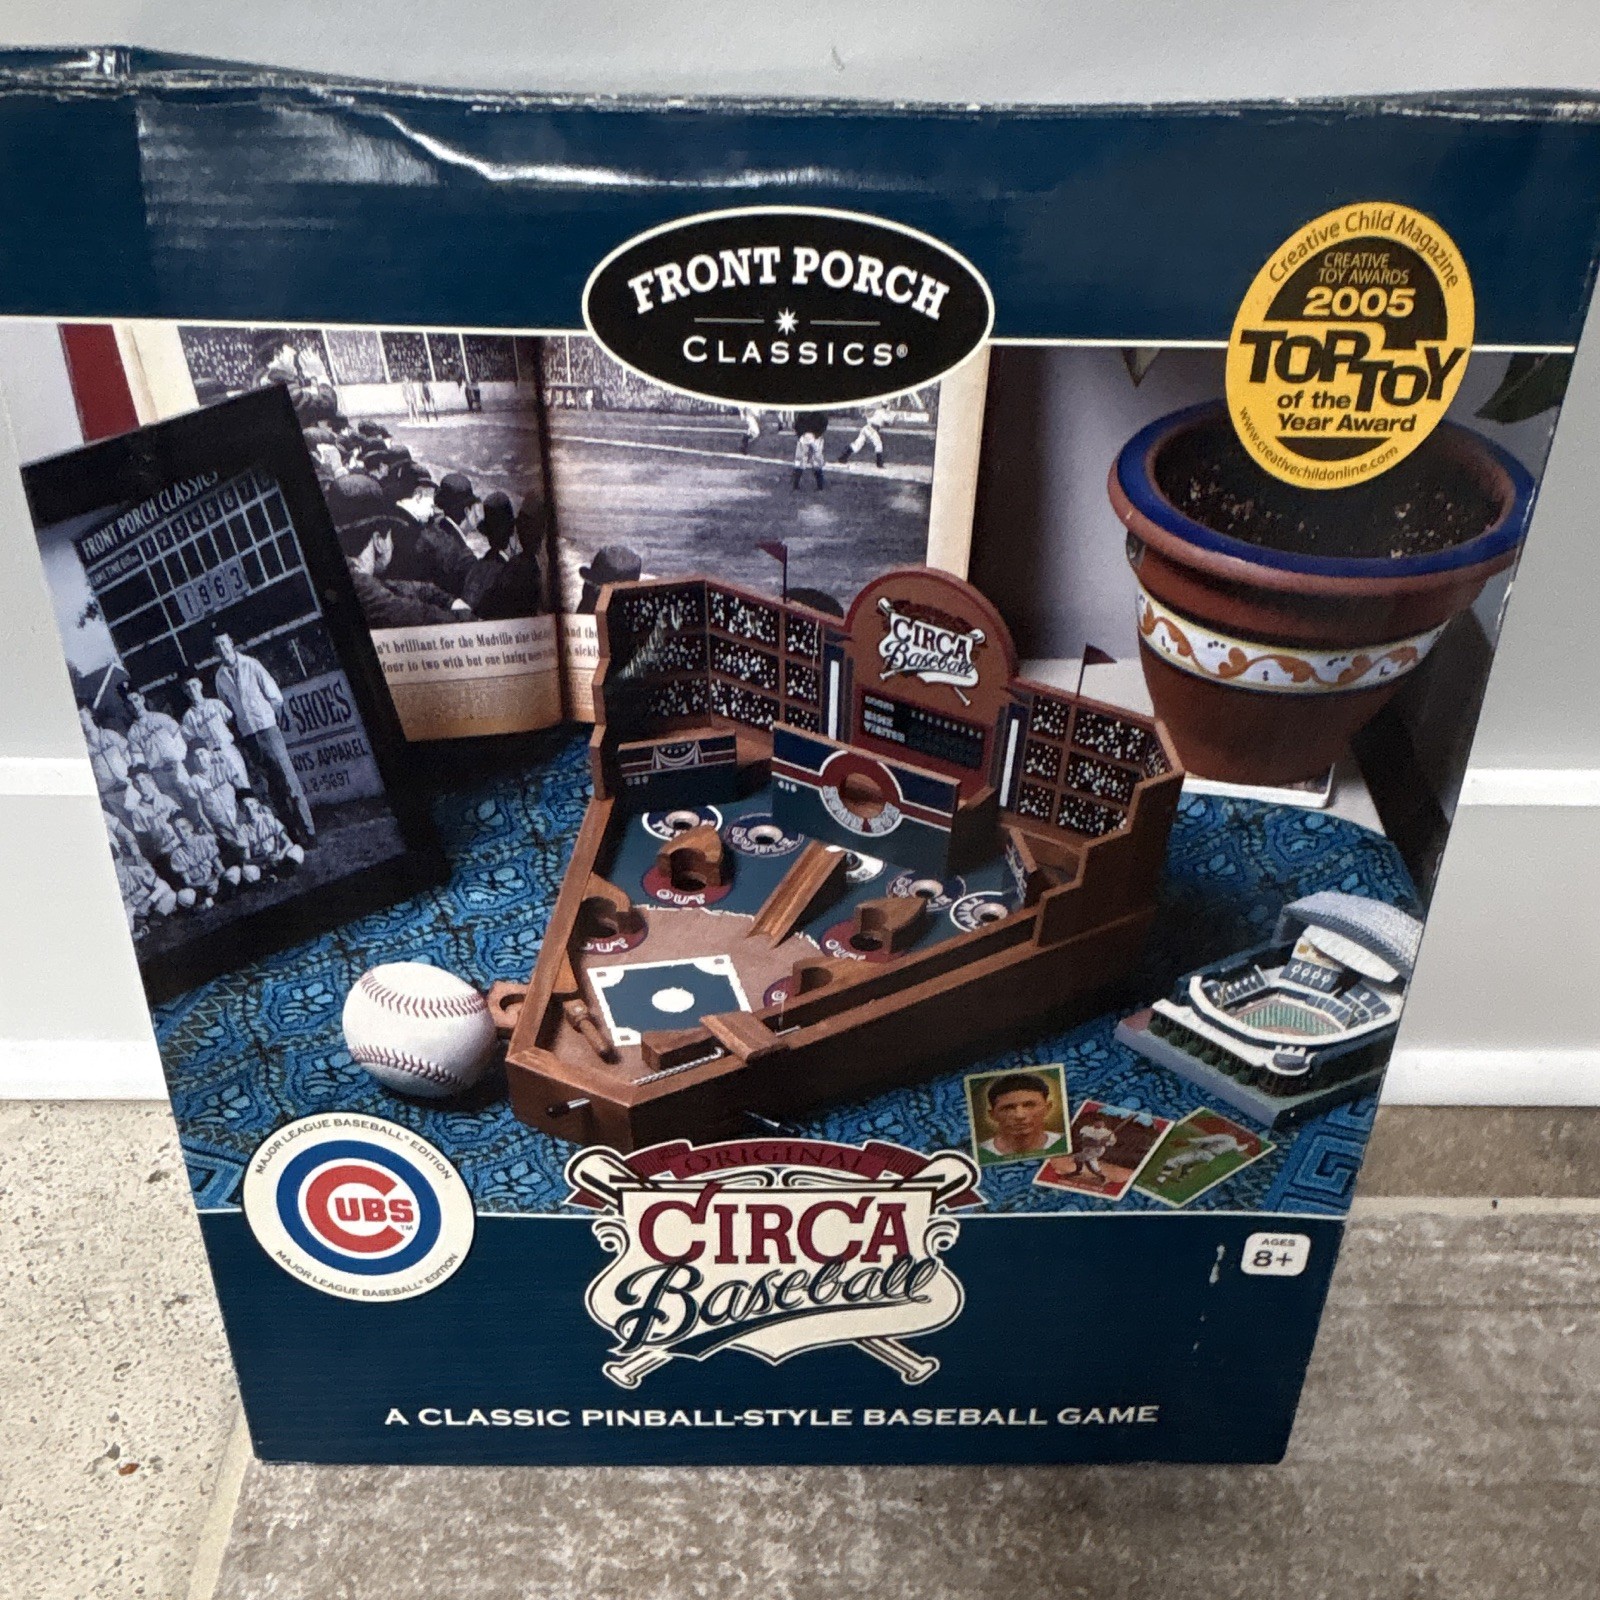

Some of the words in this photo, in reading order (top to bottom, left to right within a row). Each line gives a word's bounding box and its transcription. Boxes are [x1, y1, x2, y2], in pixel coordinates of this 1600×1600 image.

[1268, 220, 1341, 284] Creative
[1345, 209, 1395, 232] Child
[1396, 213, 1459, 288] Magazine
[1323, 251, 1390, 269] CREATIVE
[628, 246, 781, 315] FRONT
[791, 246, 951, 321] PORCH
[1318, 268, 1348, 285] TOY
[1348, 268, 1410, 285] AWARDS
[1302, 286, 1416, 318] 2005
[1240, 330, 1371, 384] TOP
[1347, 347, 1467, 413] TOY
[1277, 390, 1304, 410] of
[1311, 390, 1351, 409] the
[1278, 413, 1332, 432] Year
[1336, 413, 1417, 433] Award
[1239, 406, 1399, 482] www.creativechildonline.com
[81, 520, 120, 560] FRONT
[116, 497, 160, 540] PORCH
[392, 639, 438, 654] brilliant
[439, 636, 455, 650] for
[458, 635, 475, 648] the
[884, 638, 977, 675] Baseball
[892, 617, 969, 660] CIRCA
[442, 655, 464, 669] with
[288, 681, 353, 736] SHOES
[316, 738, 370, 768] APPAREL
[255, 1140, 283, 1175] MAJOR
[281, 1118, 332, 1143] LEAGUE
[409, 1140, 453, 1180] EDITION
[684, 1144, 863, 1172] ORIGINAL
[305, 1165, 415, 1254] CUBS
[638, 1182, 913, 1266] CIRCA
[1252, 1249, 1294, 1267] 8+
[1261, 1238, 1296, 1247] AGES
[275, 1249, 313, 1280] MAJOR
[312, 1275, 360, 1297] LEAGUE
[423, 1252, 459, 1284] EDITION
[613, 1254, 942, 1354] Baseball
[384, 1407, 410, 1426] A
[417, 1407, 571, 1427] CLASSIC
[580, 1407, 854, 1427] PINBALL-STYLE
[862, 1407, 1048, 1426] BASEBALL
[1056, 1404, 1161, 1425] GAME
